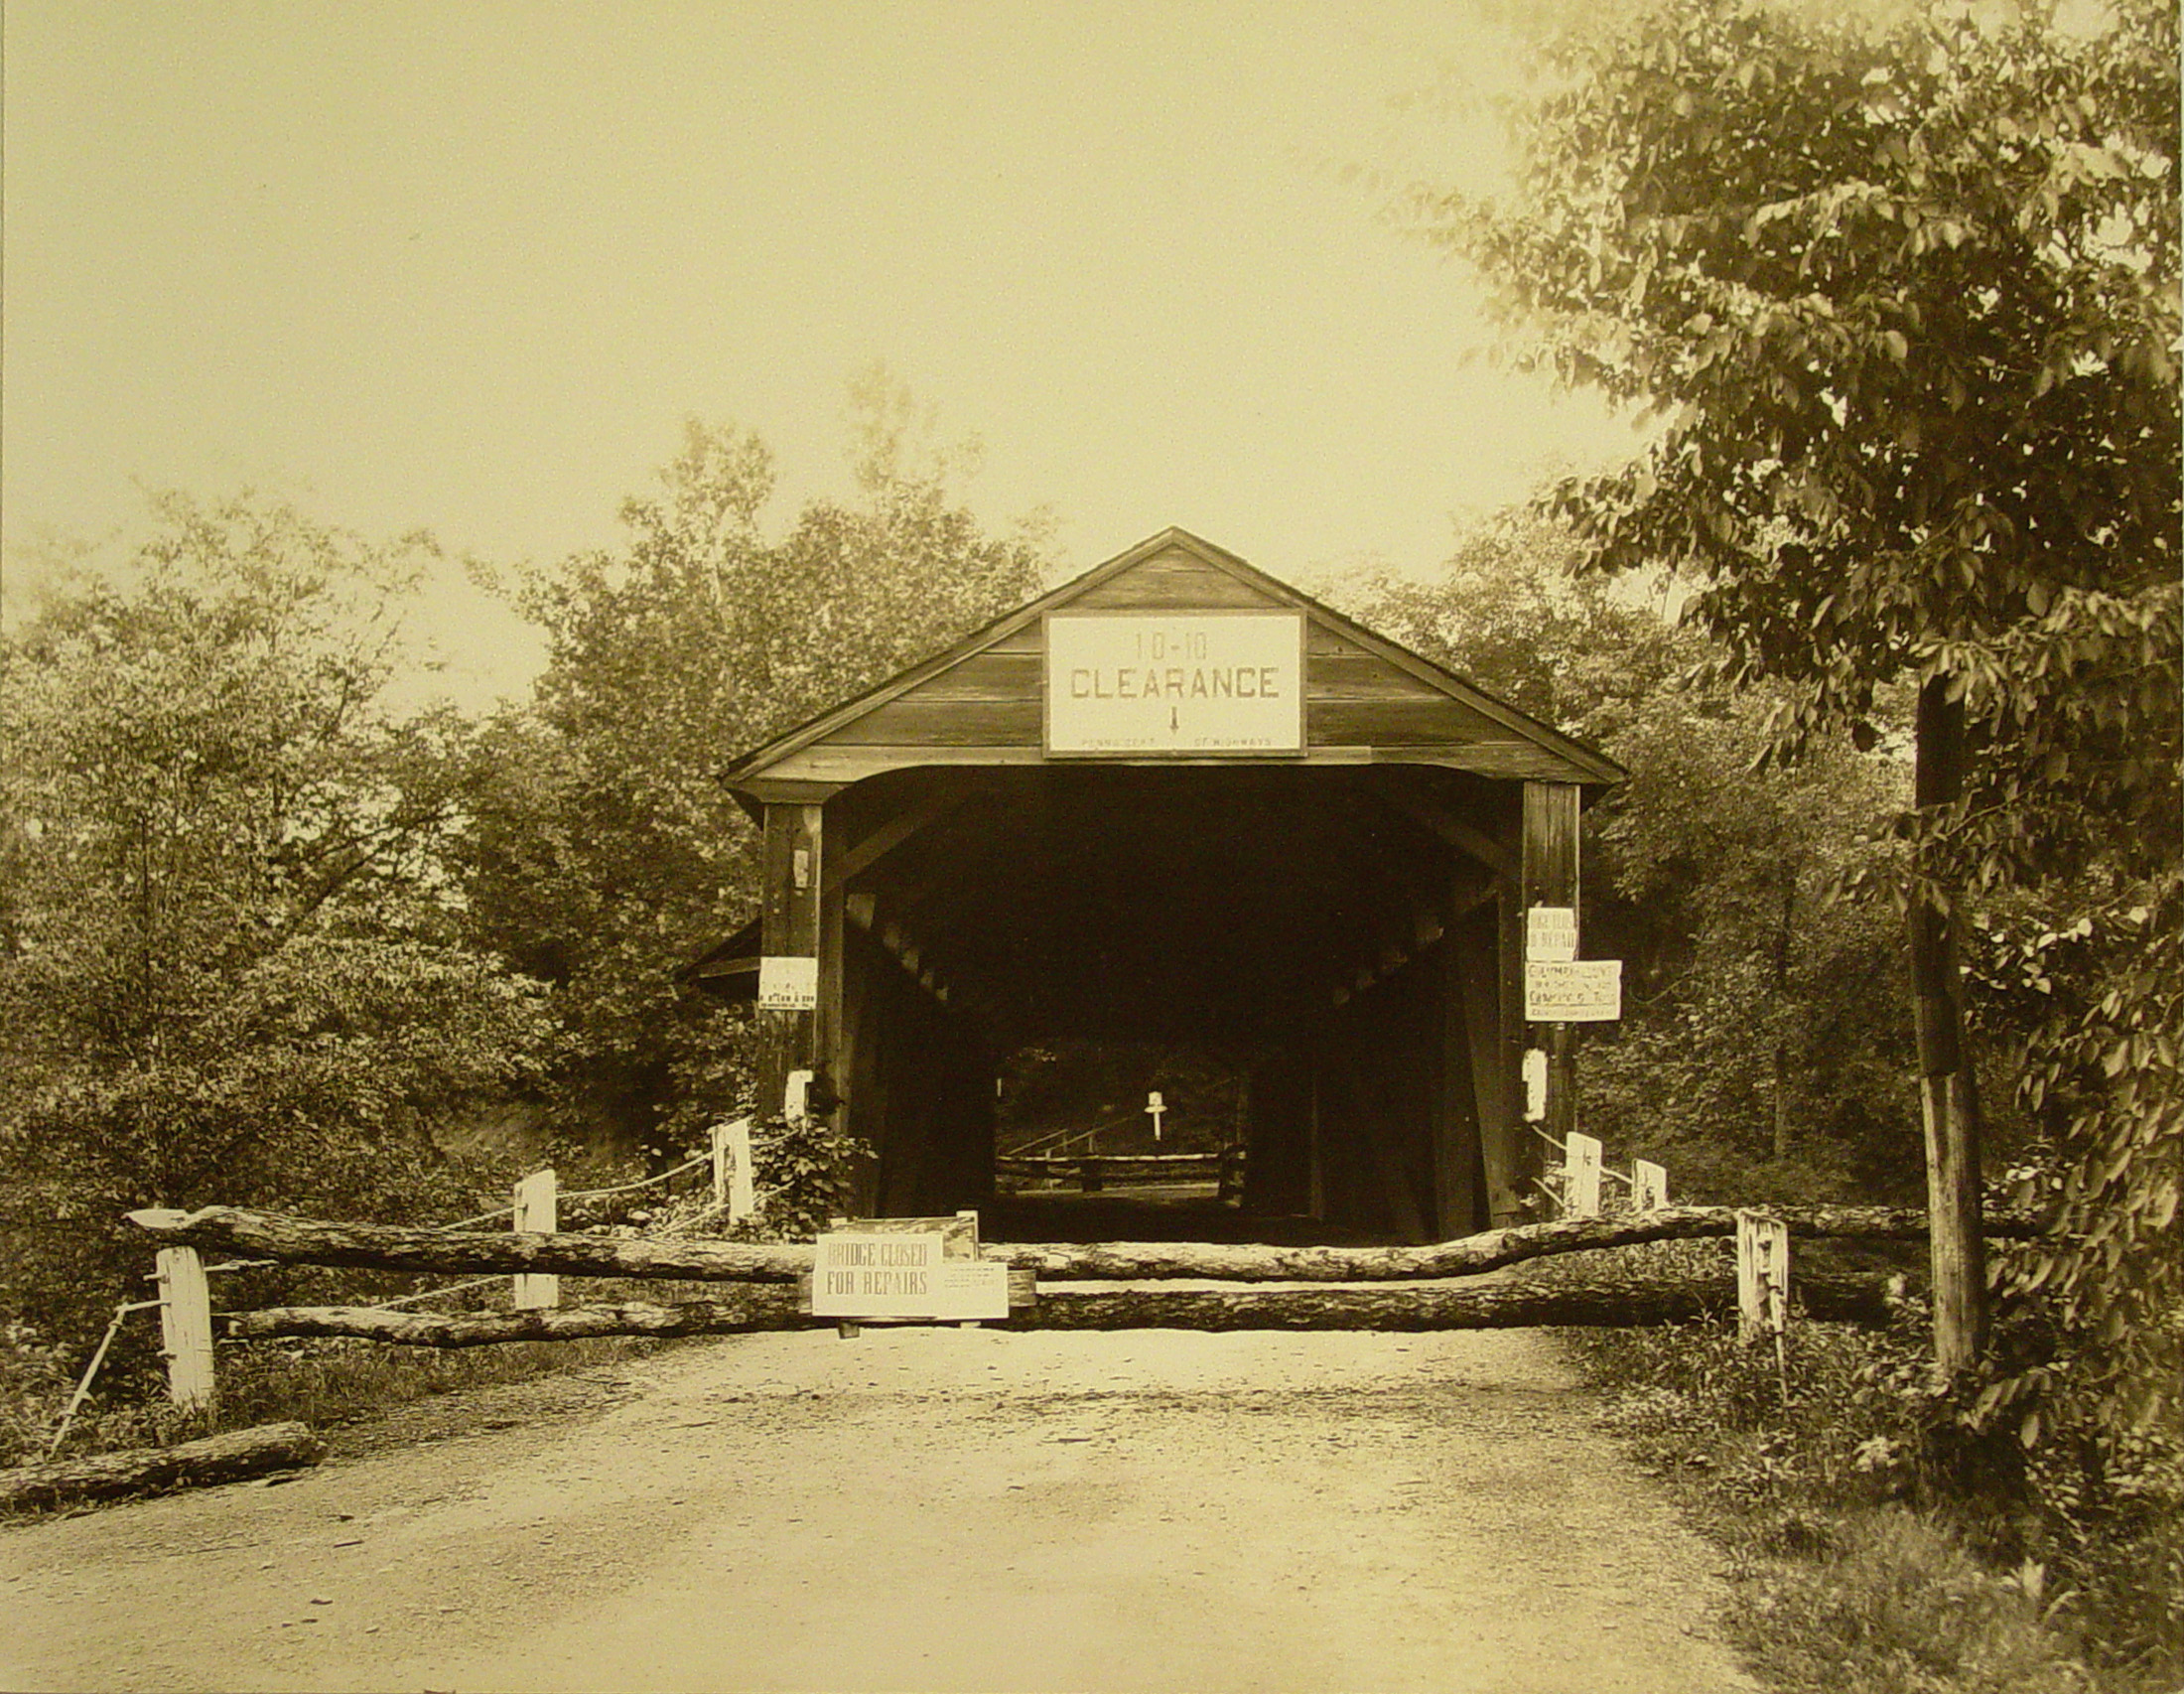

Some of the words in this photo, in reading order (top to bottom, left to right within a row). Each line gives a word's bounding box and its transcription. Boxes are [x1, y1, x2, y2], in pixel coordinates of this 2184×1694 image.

[1136, 632, 1207, 660] 10-10
[1070, 667, 1280, 698] CLEARANCE
[828, 1242, 876, 1266] BRIDGE
[881, 1243, 927, 1267] CLOSED
[827, 1271, 854, 1295] FOR
[863, 1271, 928, 1295] REPAIRS
